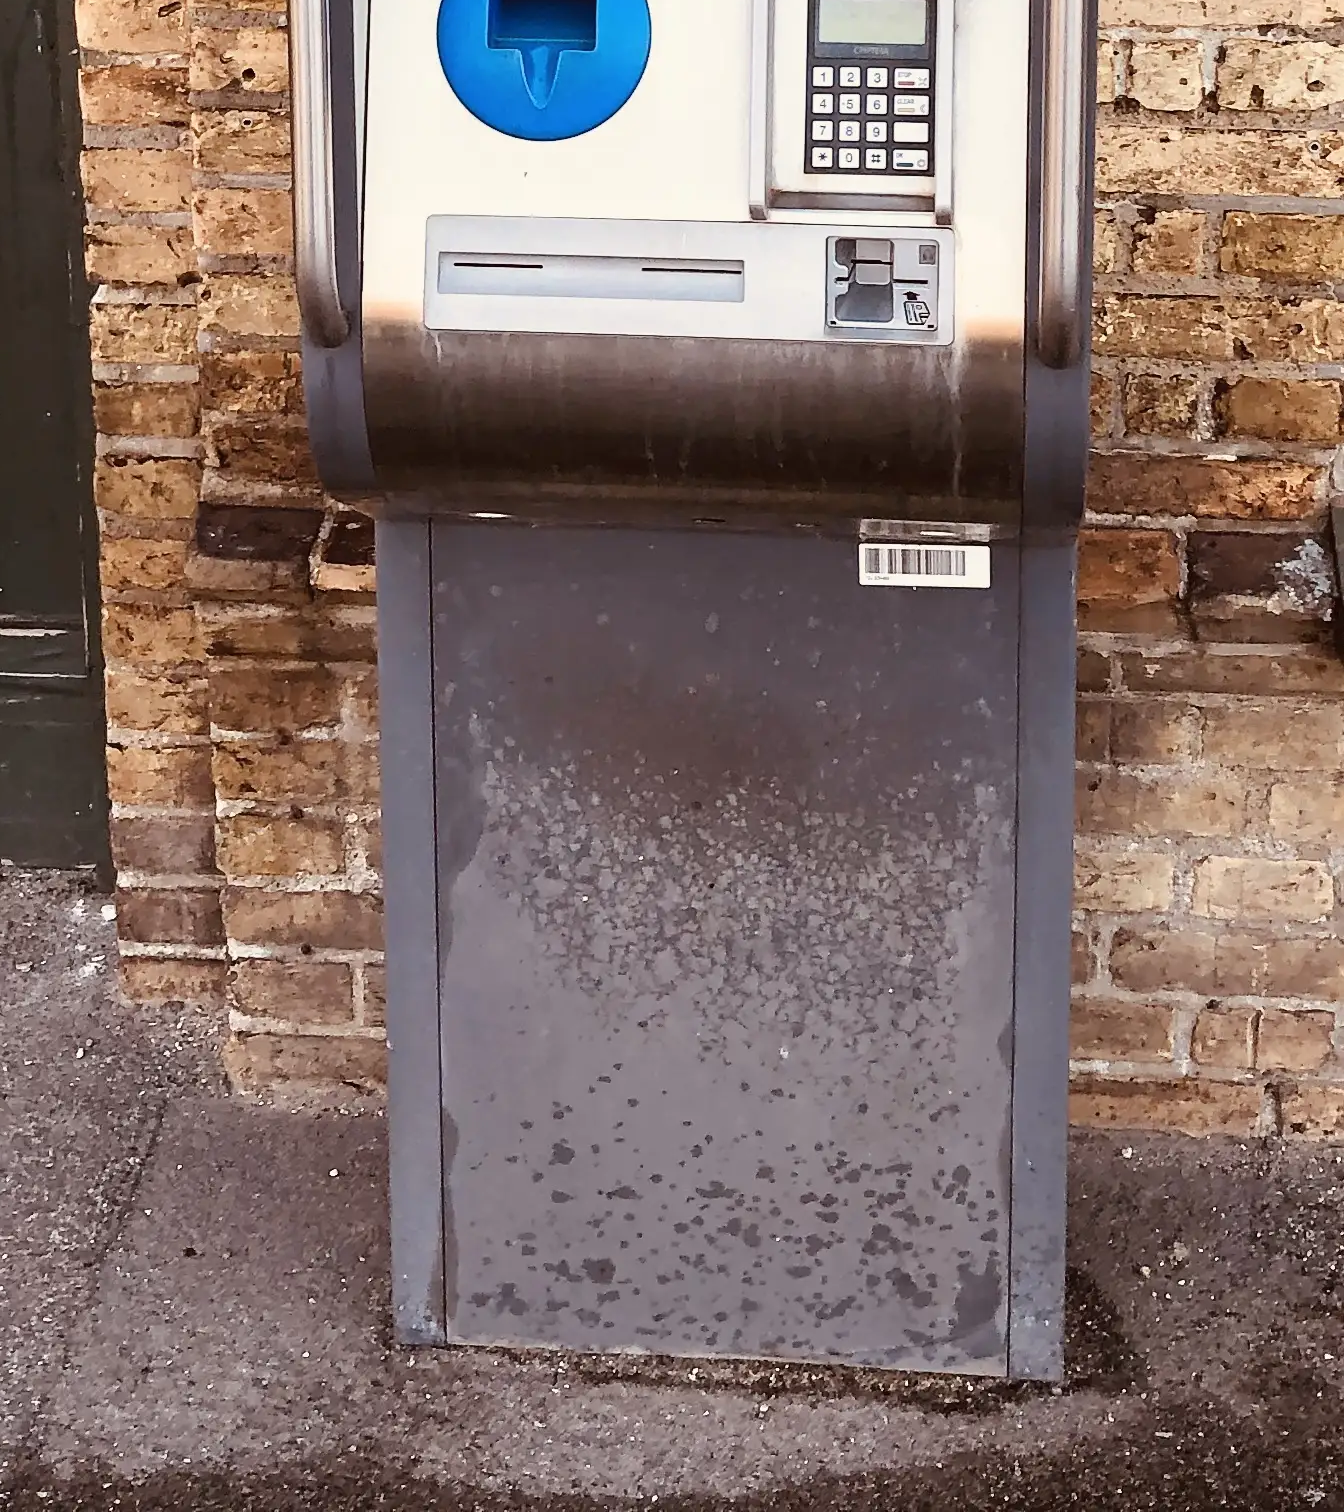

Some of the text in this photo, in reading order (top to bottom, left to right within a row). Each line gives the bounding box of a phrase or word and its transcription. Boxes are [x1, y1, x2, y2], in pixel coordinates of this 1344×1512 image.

[847, 72, 855, 83] 2
[873, 72, 882, 84] 3
[819, 98, 827, 109] 4
[846, 99, 854, 110] 5
[873, 99, 882, 110] 6
[819, 125, 881, 138] 7 8 9
[845, 152, 853, 163] 0
